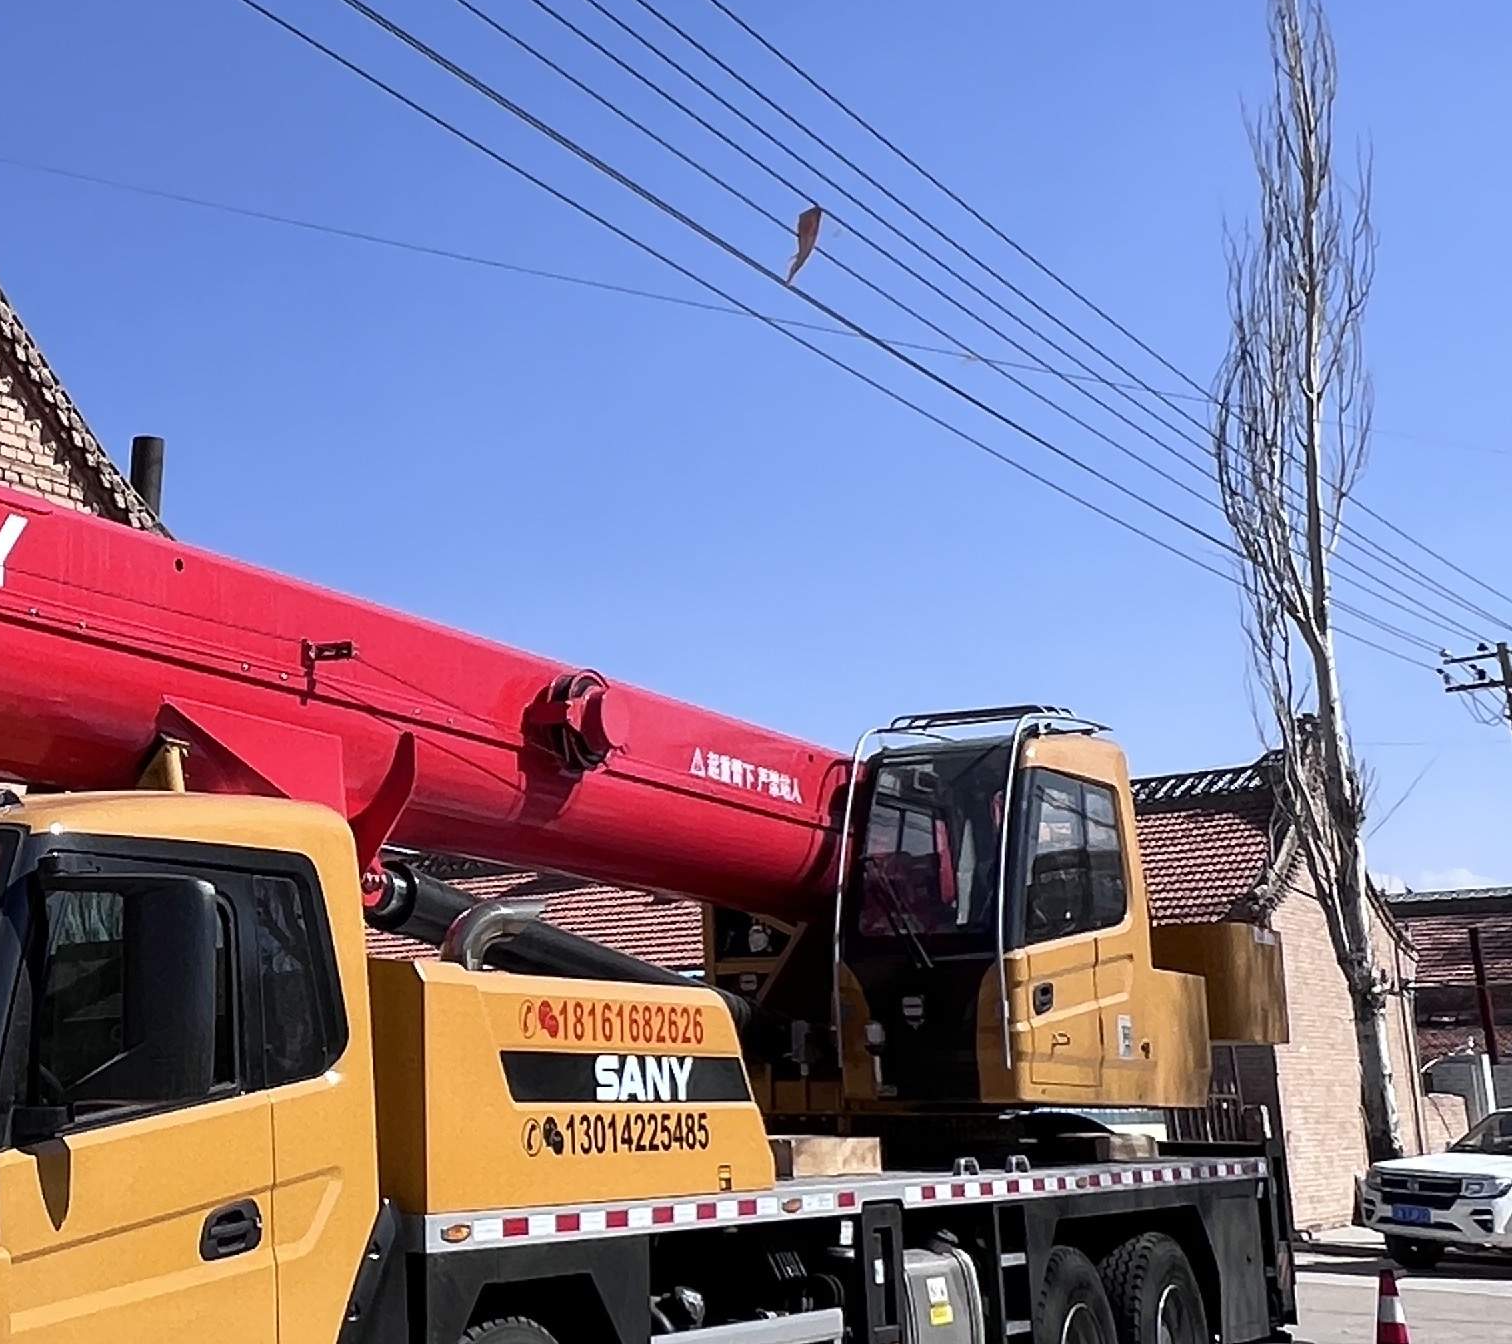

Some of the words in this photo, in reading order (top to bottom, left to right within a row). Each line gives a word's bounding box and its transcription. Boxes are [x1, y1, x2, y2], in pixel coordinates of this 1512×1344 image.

[559, 1000, 704, 1044] 18161682626
[594, 1054, 694, 1102] SANY
[566, 1112, 710, 1155] 13014225485
